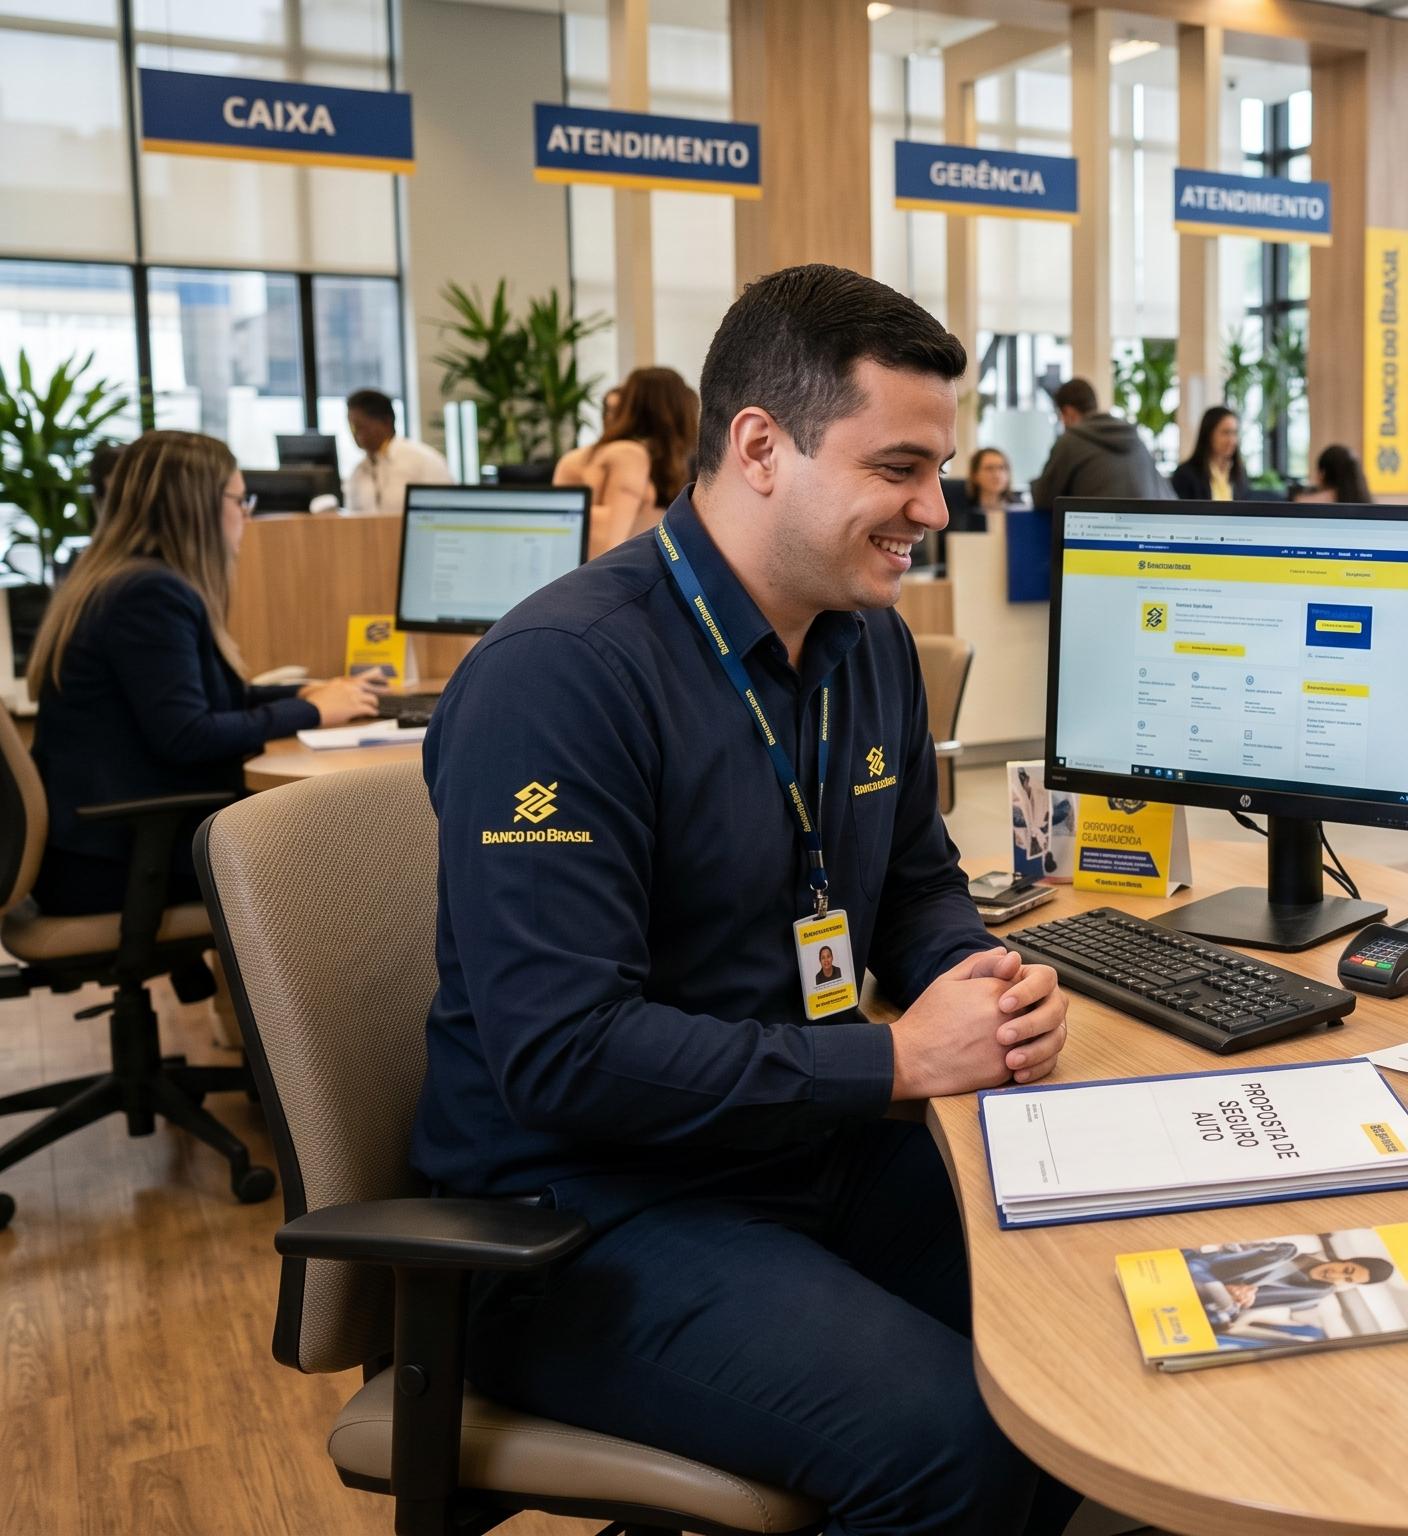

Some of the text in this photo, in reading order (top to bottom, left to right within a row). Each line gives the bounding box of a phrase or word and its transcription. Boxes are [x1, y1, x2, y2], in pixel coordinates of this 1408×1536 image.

[222, 96, 335, 136] CAIXA
[547, 124, 750, 169] ATENDIMENTO
[930, 160, 1046, 195] GERÊNCIA
[1180, 184, 1324, 221] ATENDIMENTO
[482, 828, 594, 844] BANCO DO BRASIL
[1191, 1112, 1225, 1141] AUTO
[1218, 1100, 1260, 1147] SEGURO
[1240, 1083, 1300, 1159] PROPOSTA DE
